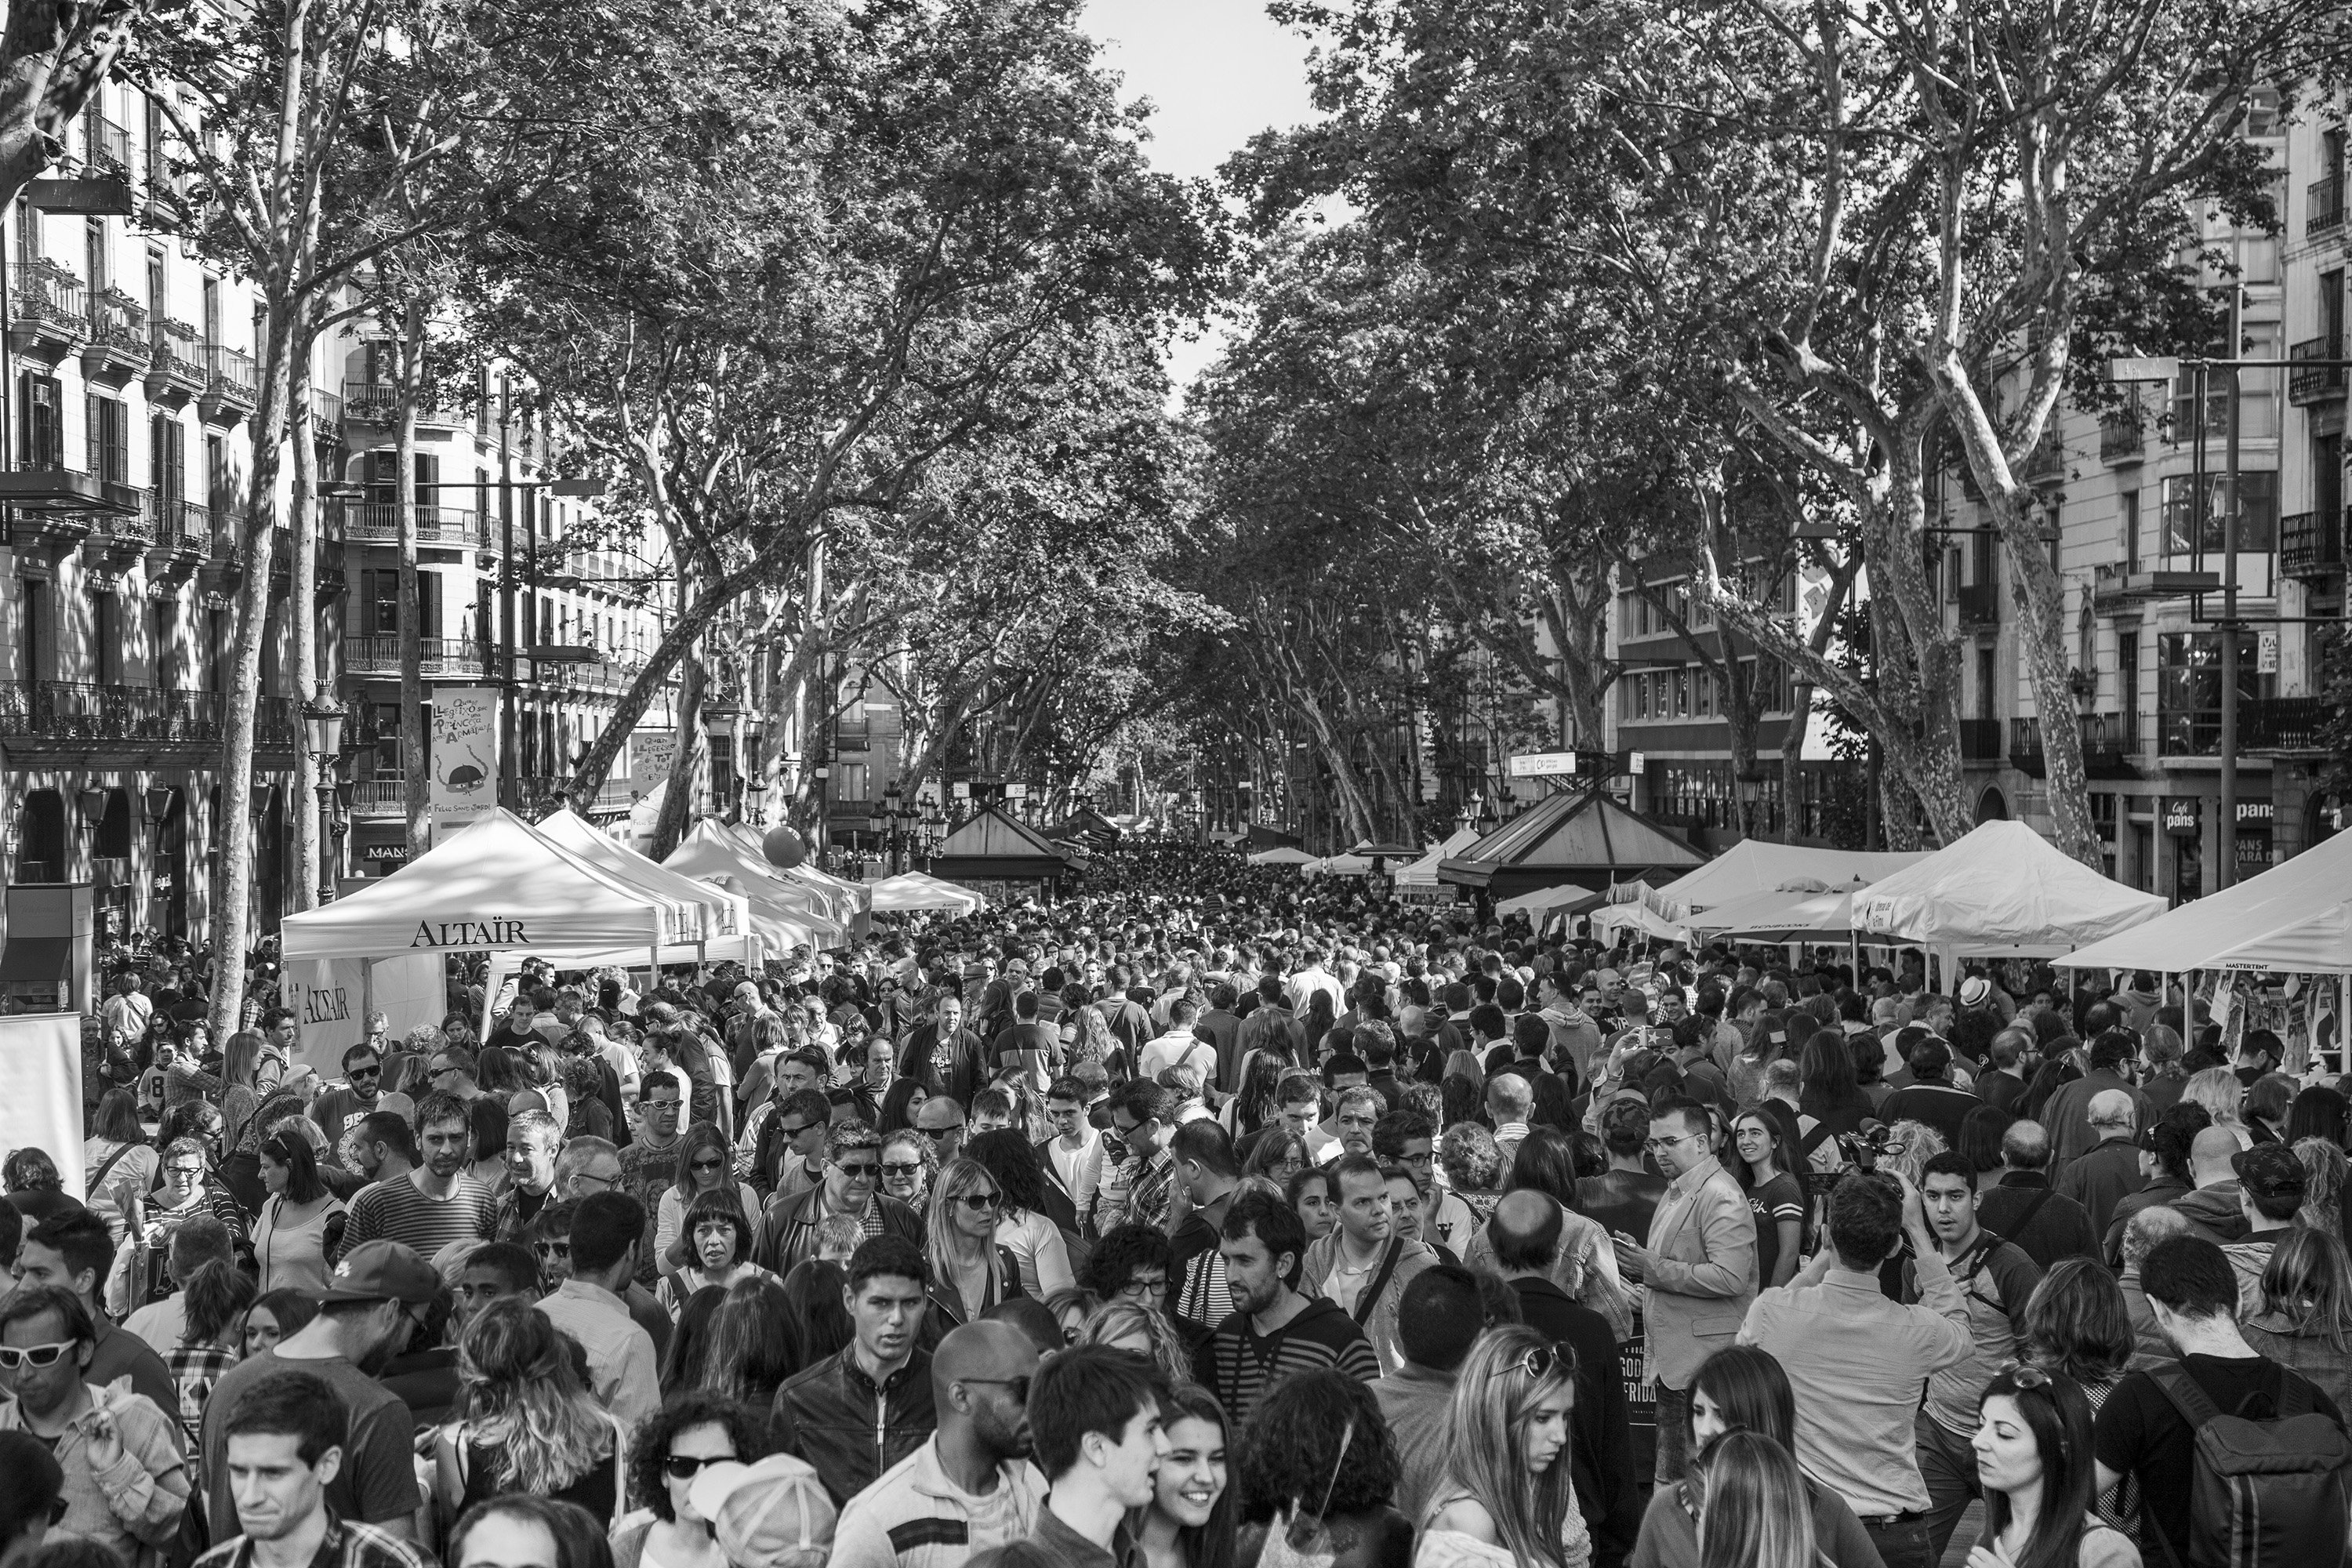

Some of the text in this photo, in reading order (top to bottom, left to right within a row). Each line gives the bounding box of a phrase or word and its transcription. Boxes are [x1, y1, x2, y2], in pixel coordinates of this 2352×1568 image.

[2167, 815, 2194, 830] pans
[409, 916, 531, 948] ALTAÏR
[151, 1076, 165, 1098] 8
